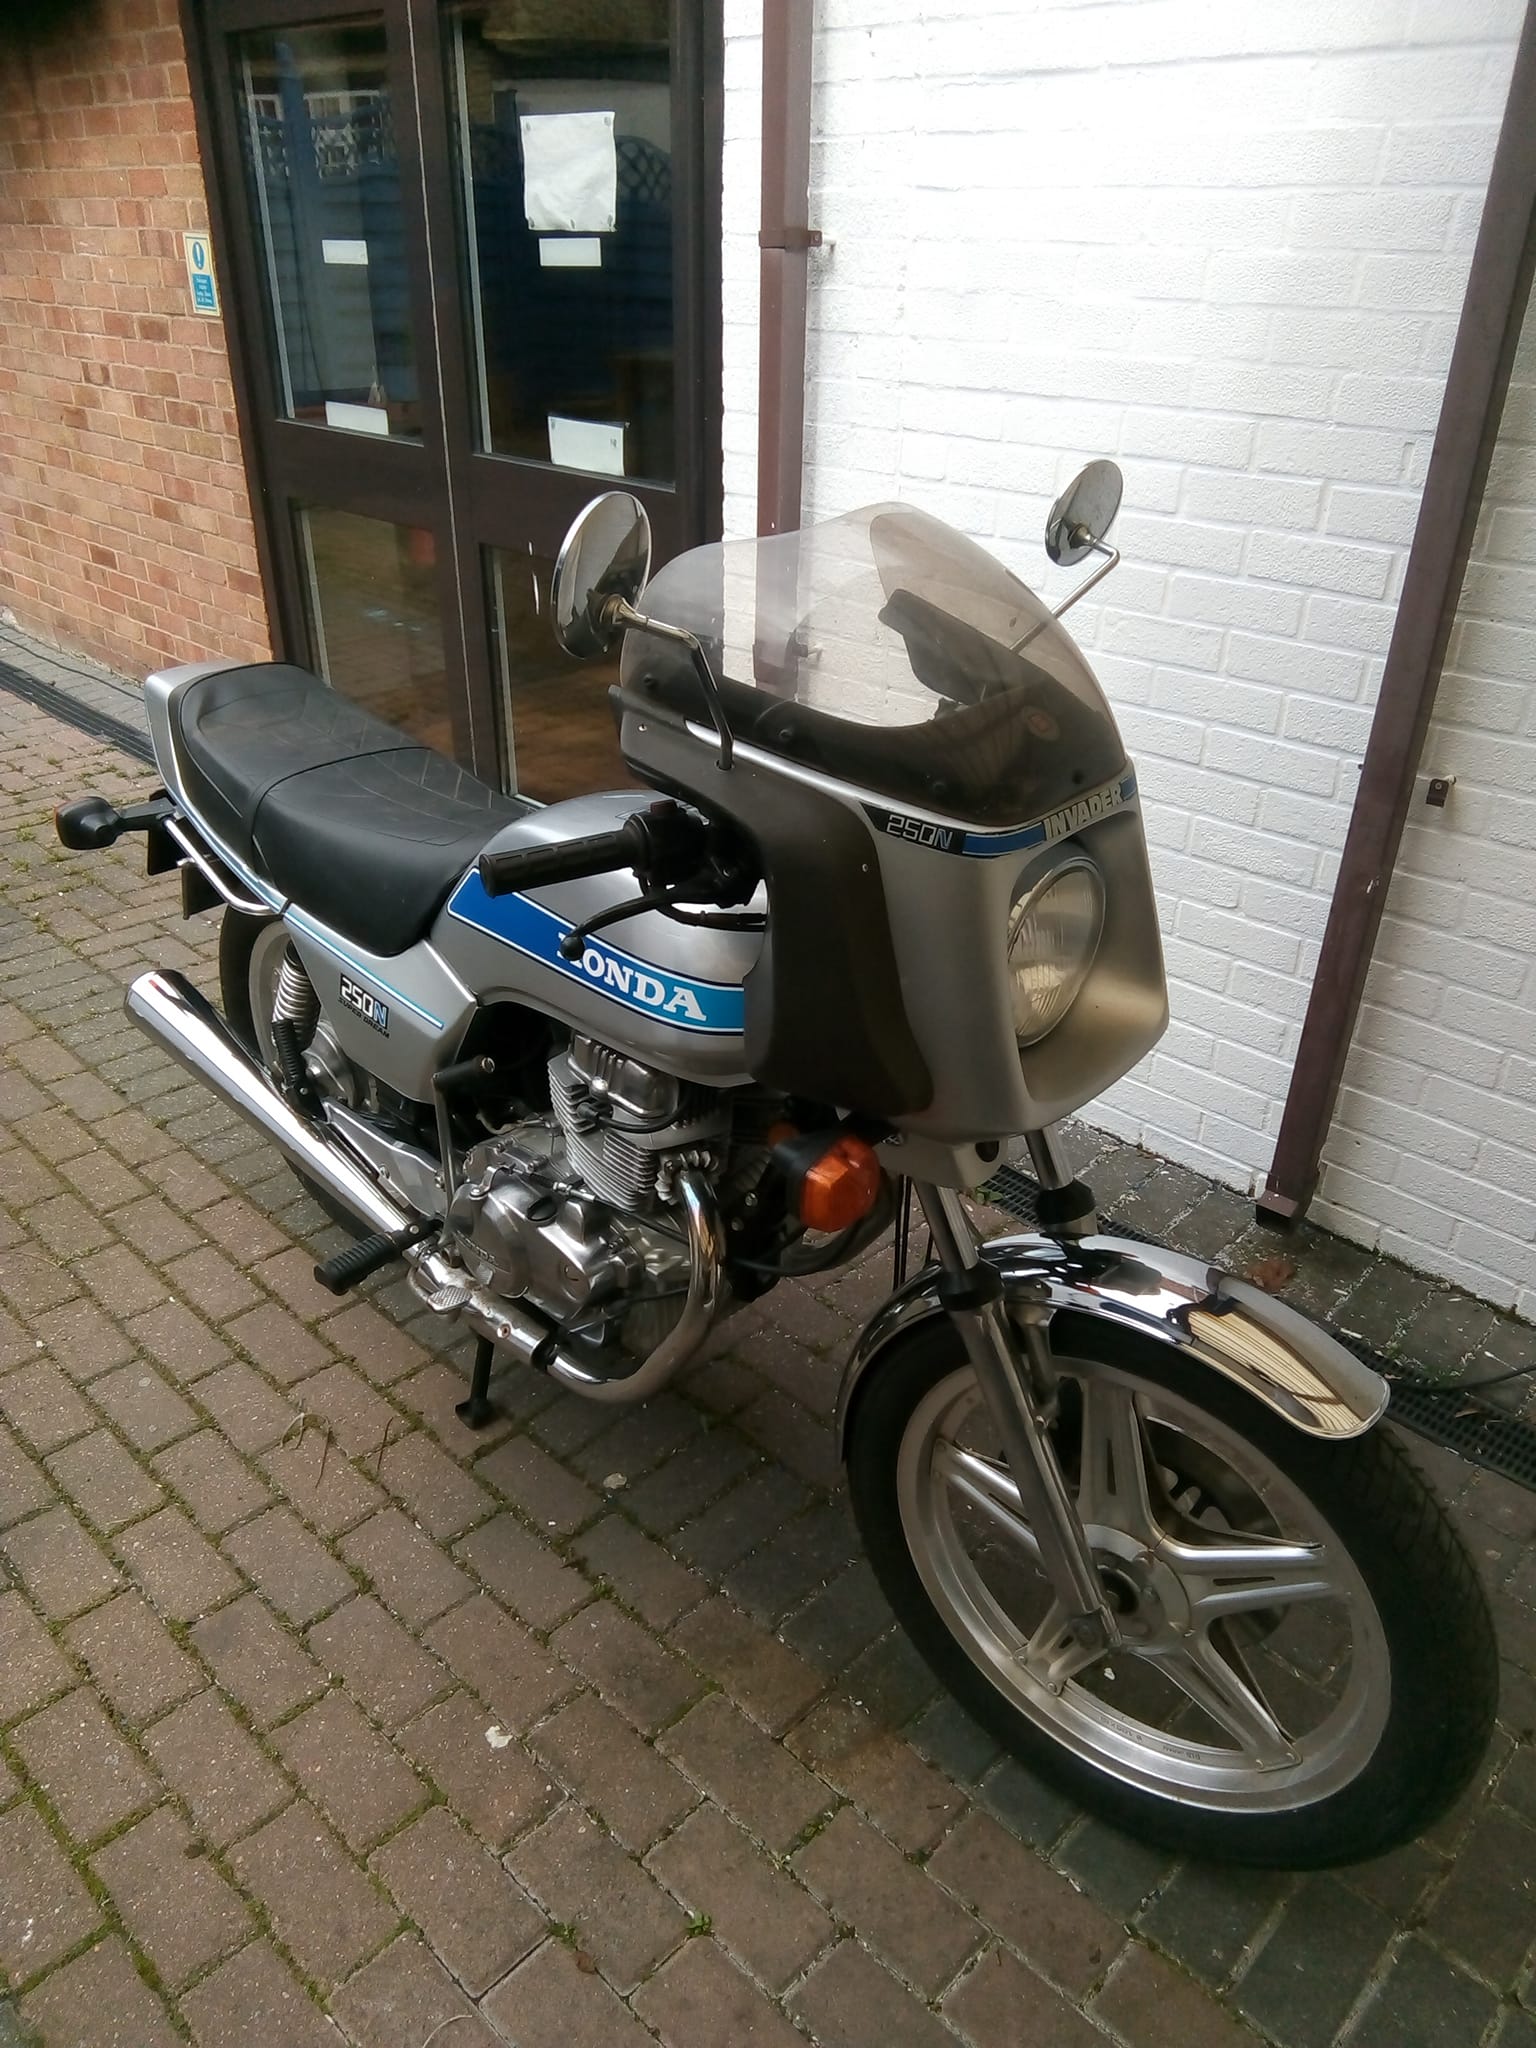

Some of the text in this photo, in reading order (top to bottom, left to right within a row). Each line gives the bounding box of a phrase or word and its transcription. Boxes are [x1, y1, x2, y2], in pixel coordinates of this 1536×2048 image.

[886, 787, 1122, 850] 250N INVADER
[338, 997, 390, 1039] SUPER DREAM
[341, 976, 387, 1027] 250N
